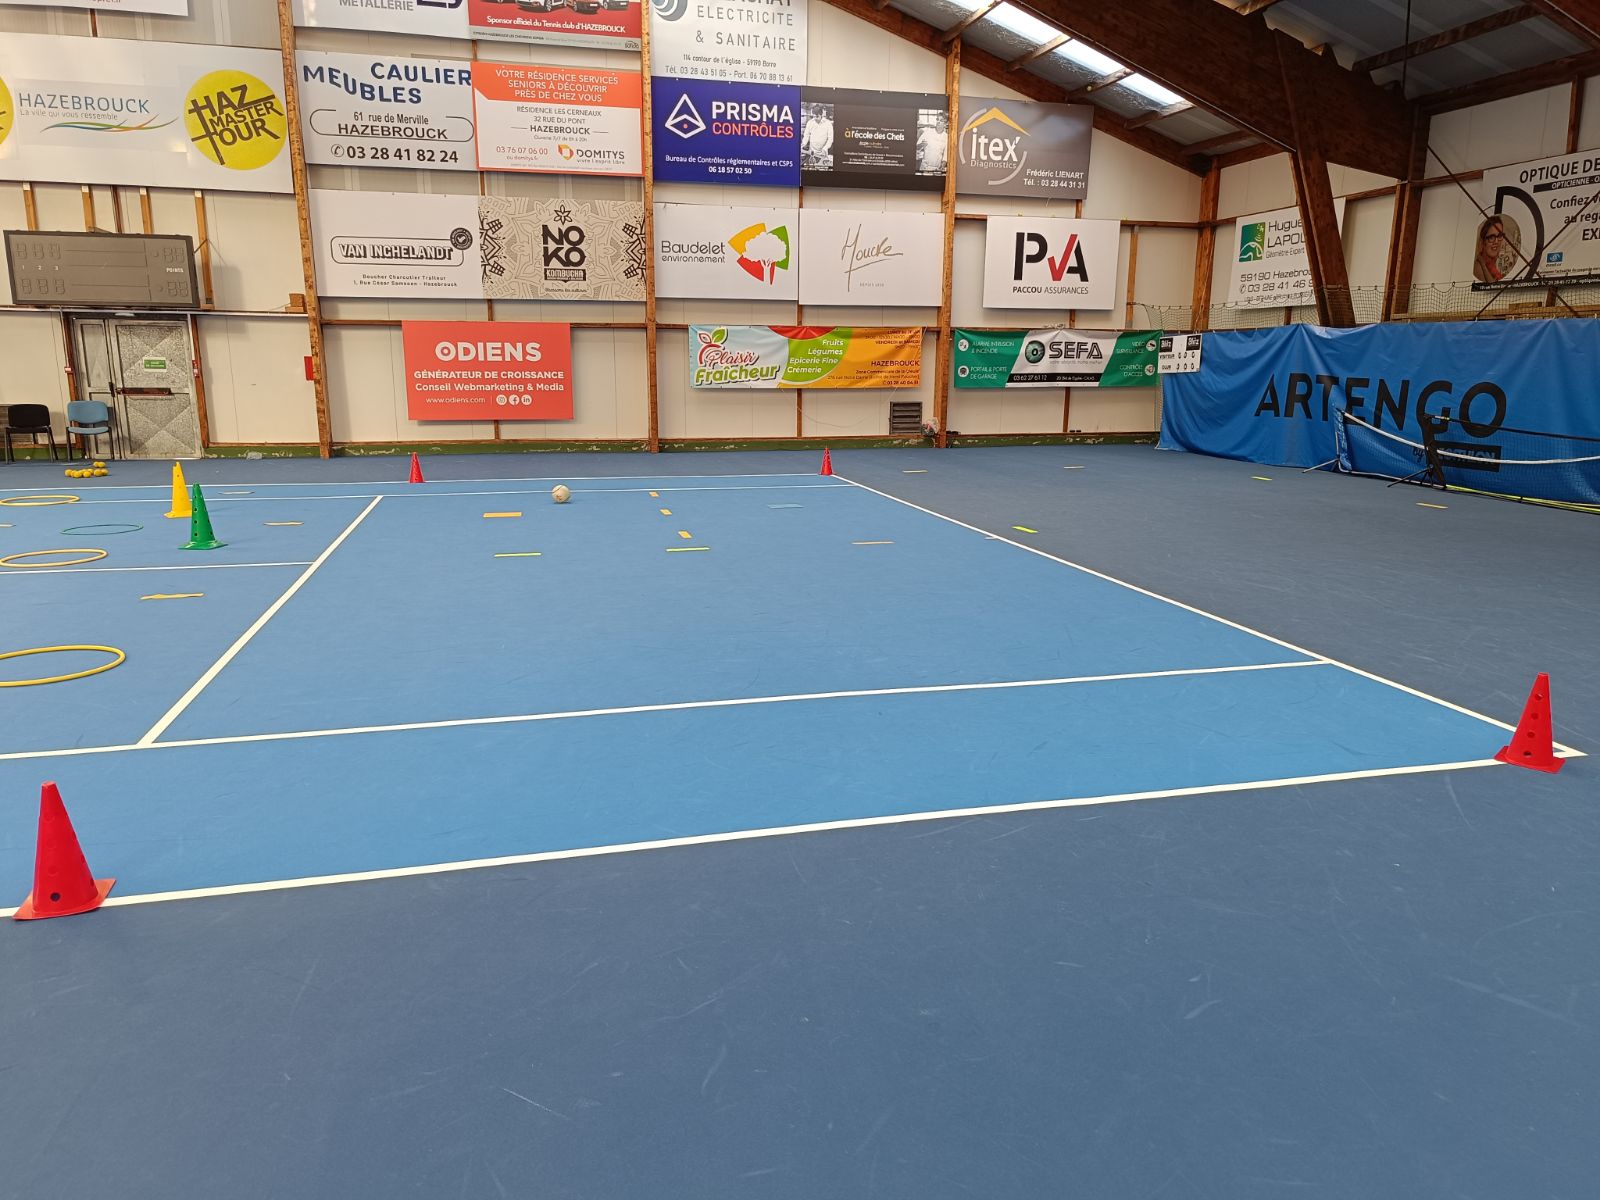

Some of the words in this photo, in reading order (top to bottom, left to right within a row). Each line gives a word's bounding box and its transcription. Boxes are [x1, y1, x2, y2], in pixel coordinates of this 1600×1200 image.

[697, 5, 793, 26] ELECTRICITE
[486, 15, 512, 24] Sponsor
[513, 18, 532, 26] officiel
[542, 20, 562, 28] Tennis
[576, 22, 626, 33] d'HAZEBROUCK
[696, 30, 704, 44] &
[716, 32, 796, 51] SANITAIRE
[720, 57, 741, 66] l'église
[370, 62, 472, 86] CAULIER
[496, 70, 525, 79] VOTRE
[528, 70, 576, 82] RÉSIDENCE
[578, 74, 618, 85] SERVICES
[665, 65, 677, 74] Tél.
[680, 66, 688, 74] 03
[690, 67, 698, 75] 28
[718, 69, 727, 77] 05
[734, 70, 748, 78] Port.
[749, 72, 757, 80] 06
[303, 65, 422, 104] MEUBLES
[508, 80, 546, 90] SENIORS
[549, 81, 555, 90] À
[557, 82, 608, 93] DÉCOUVRIR
[19, 92, 150, 114] HAZEBROUCK
[188, 84, 275, 117] HAZ
[514, 89, 536, 98] PRÈS
[538, 91, 550, 99] DE
[553, 92, 576, 101] CHEZ
[579, 93, 602, 102] VOUS
[80, 112, 118, 120] ressemble
[208, 100, 284, 128] MASTER
[353, 112, 364, 122] 61
[368, 114, 382, 123] rue
[384, 113, 394, 123] de
[396, 114, 429, 125] Merville
[516, 106, 553, 114] RÉSIDENCE
[566, 108, 602, 117] CERNEAUX
[711, 101, 794, 124] PRISMA
[338, 123, 448, 140] HAZEBROUCK
[530, 125, 591, 135] HAZEBROUCK
[712, 122, 794, 139] CONTRÔLES
[844, 128, 850, 138] à
[852, 130, 873, 139] l'école
[886, 132, 905, 140] Chefs
[191, 118, 280, 165] TOUR
[346, 145, 366, 159] 03
[370, 146, 390, 160] 28
[394, 148, 411, 161] 41
[417, 149, 436, 162] 82
[439, 150, 459, 163] 24
[576, 149, 625, 159] DOMITYS
[665, 154, 688, 163] Bureau
[697, 156, 726, 164] Contrôles
[726, 157, 770, 167] réglementaires
[970, 160, 1017, 169] Diagnostics
[1520, 160, 1579, 183] OPTIQUE
[1026, 168, 1054, 178] Frédéric
[1055, 170, 1084, 180] LIENART
[1551, 177, 1589, 190] OPTICIENNE
[1550, 195, 1590, 210] Confiez
[541, 224, 586, 246] NO
[338, 244, 368, 258] VAN
[370, 244, 454, 261] INGHELANDT
[661, 240, 726, 255] Baudelet
[542, 246, 587, 267] KO
[661, 255, 726, 264] environnement
[1014, 232, 1089, 282] PVA
[1240, 272, 1271, 282] 59190
[1248, 284, 1260, 292] 03
[1262, 282, 1275, 292] 28
[1293, 280, 1306, 288] 46
[435, 341, 542, 362] ODIENS
[704, 348, 758, 367] Plaisir
[1049, 341, 1103, 359] SEFA
[414, 369, 482, 379] GÉNÉRATEUR
[484, 371, 498, 379] DE
[500, 371, 564, 379] CROISSANCE
[694, 364, 778, 384] Fraîcheur
[415, 383, 451, 391] Conseil
[454, 383, 524, 393] Webmarketing
[425, 396, 486, 404] www.odiens.com
[1254, 373, 1508, 438] ARTENGO
